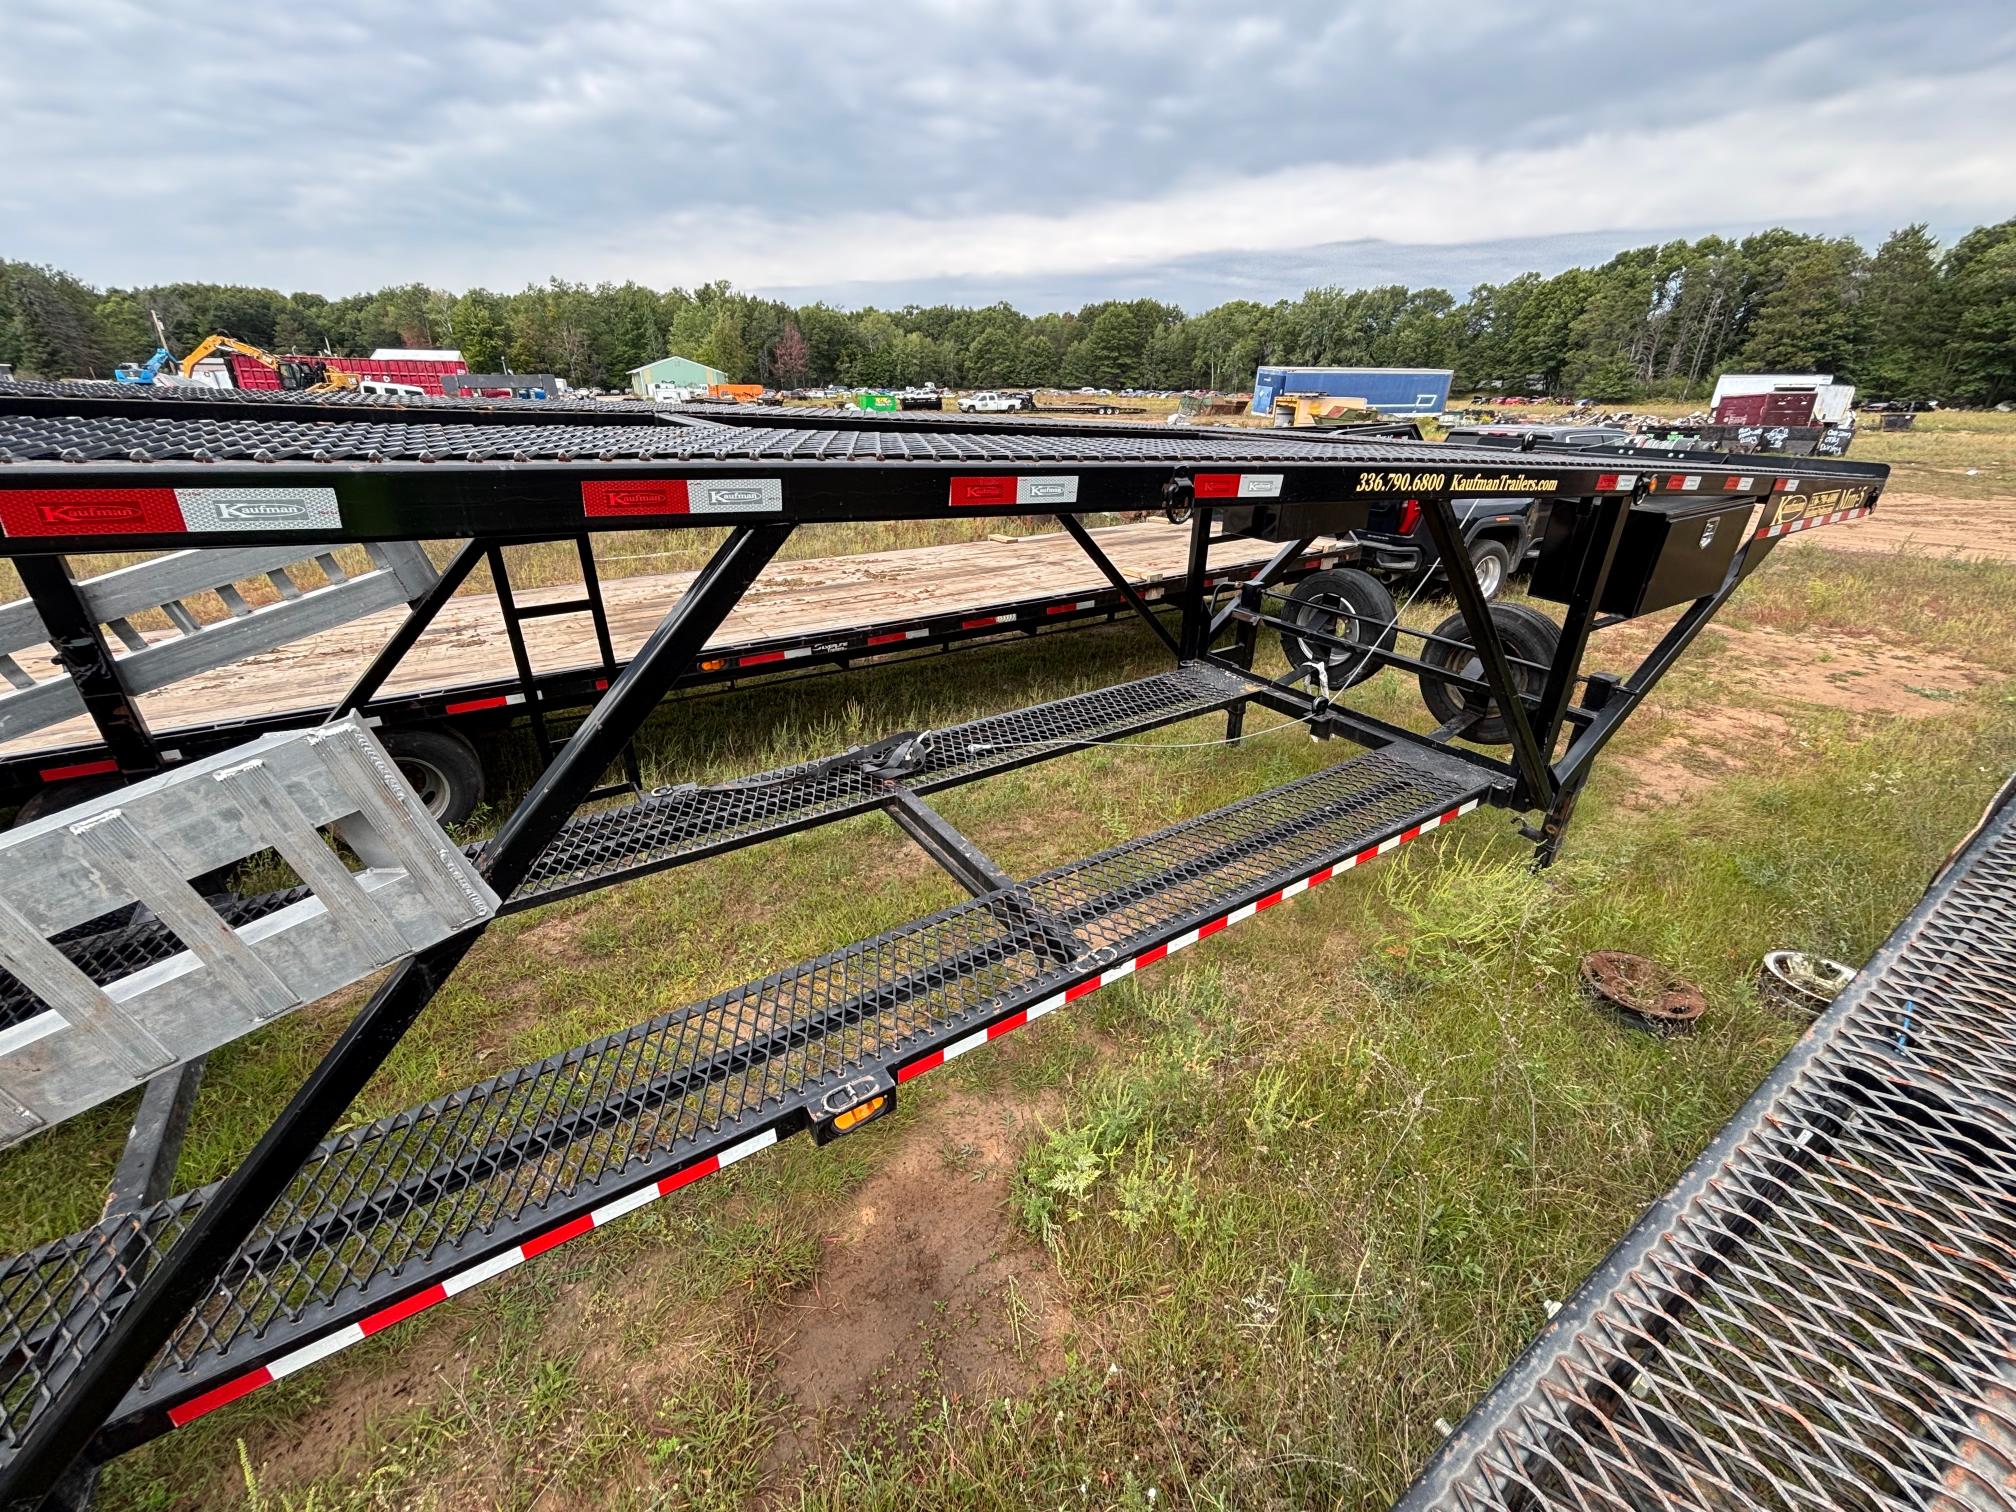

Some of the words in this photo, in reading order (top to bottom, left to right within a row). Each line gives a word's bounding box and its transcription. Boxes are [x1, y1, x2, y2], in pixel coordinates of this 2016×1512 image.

[1356, 472, 1445, 492] 336.790.6800
[1449, 473, 1558, 491] KaufmanTrailers.com
[607, 492, 661, 506] Kaufman
[710, 491, 758, 503] Kaufman
[40, 505, 133, 521] Kaufman
[214, 503, 300, 519] Kaufman
